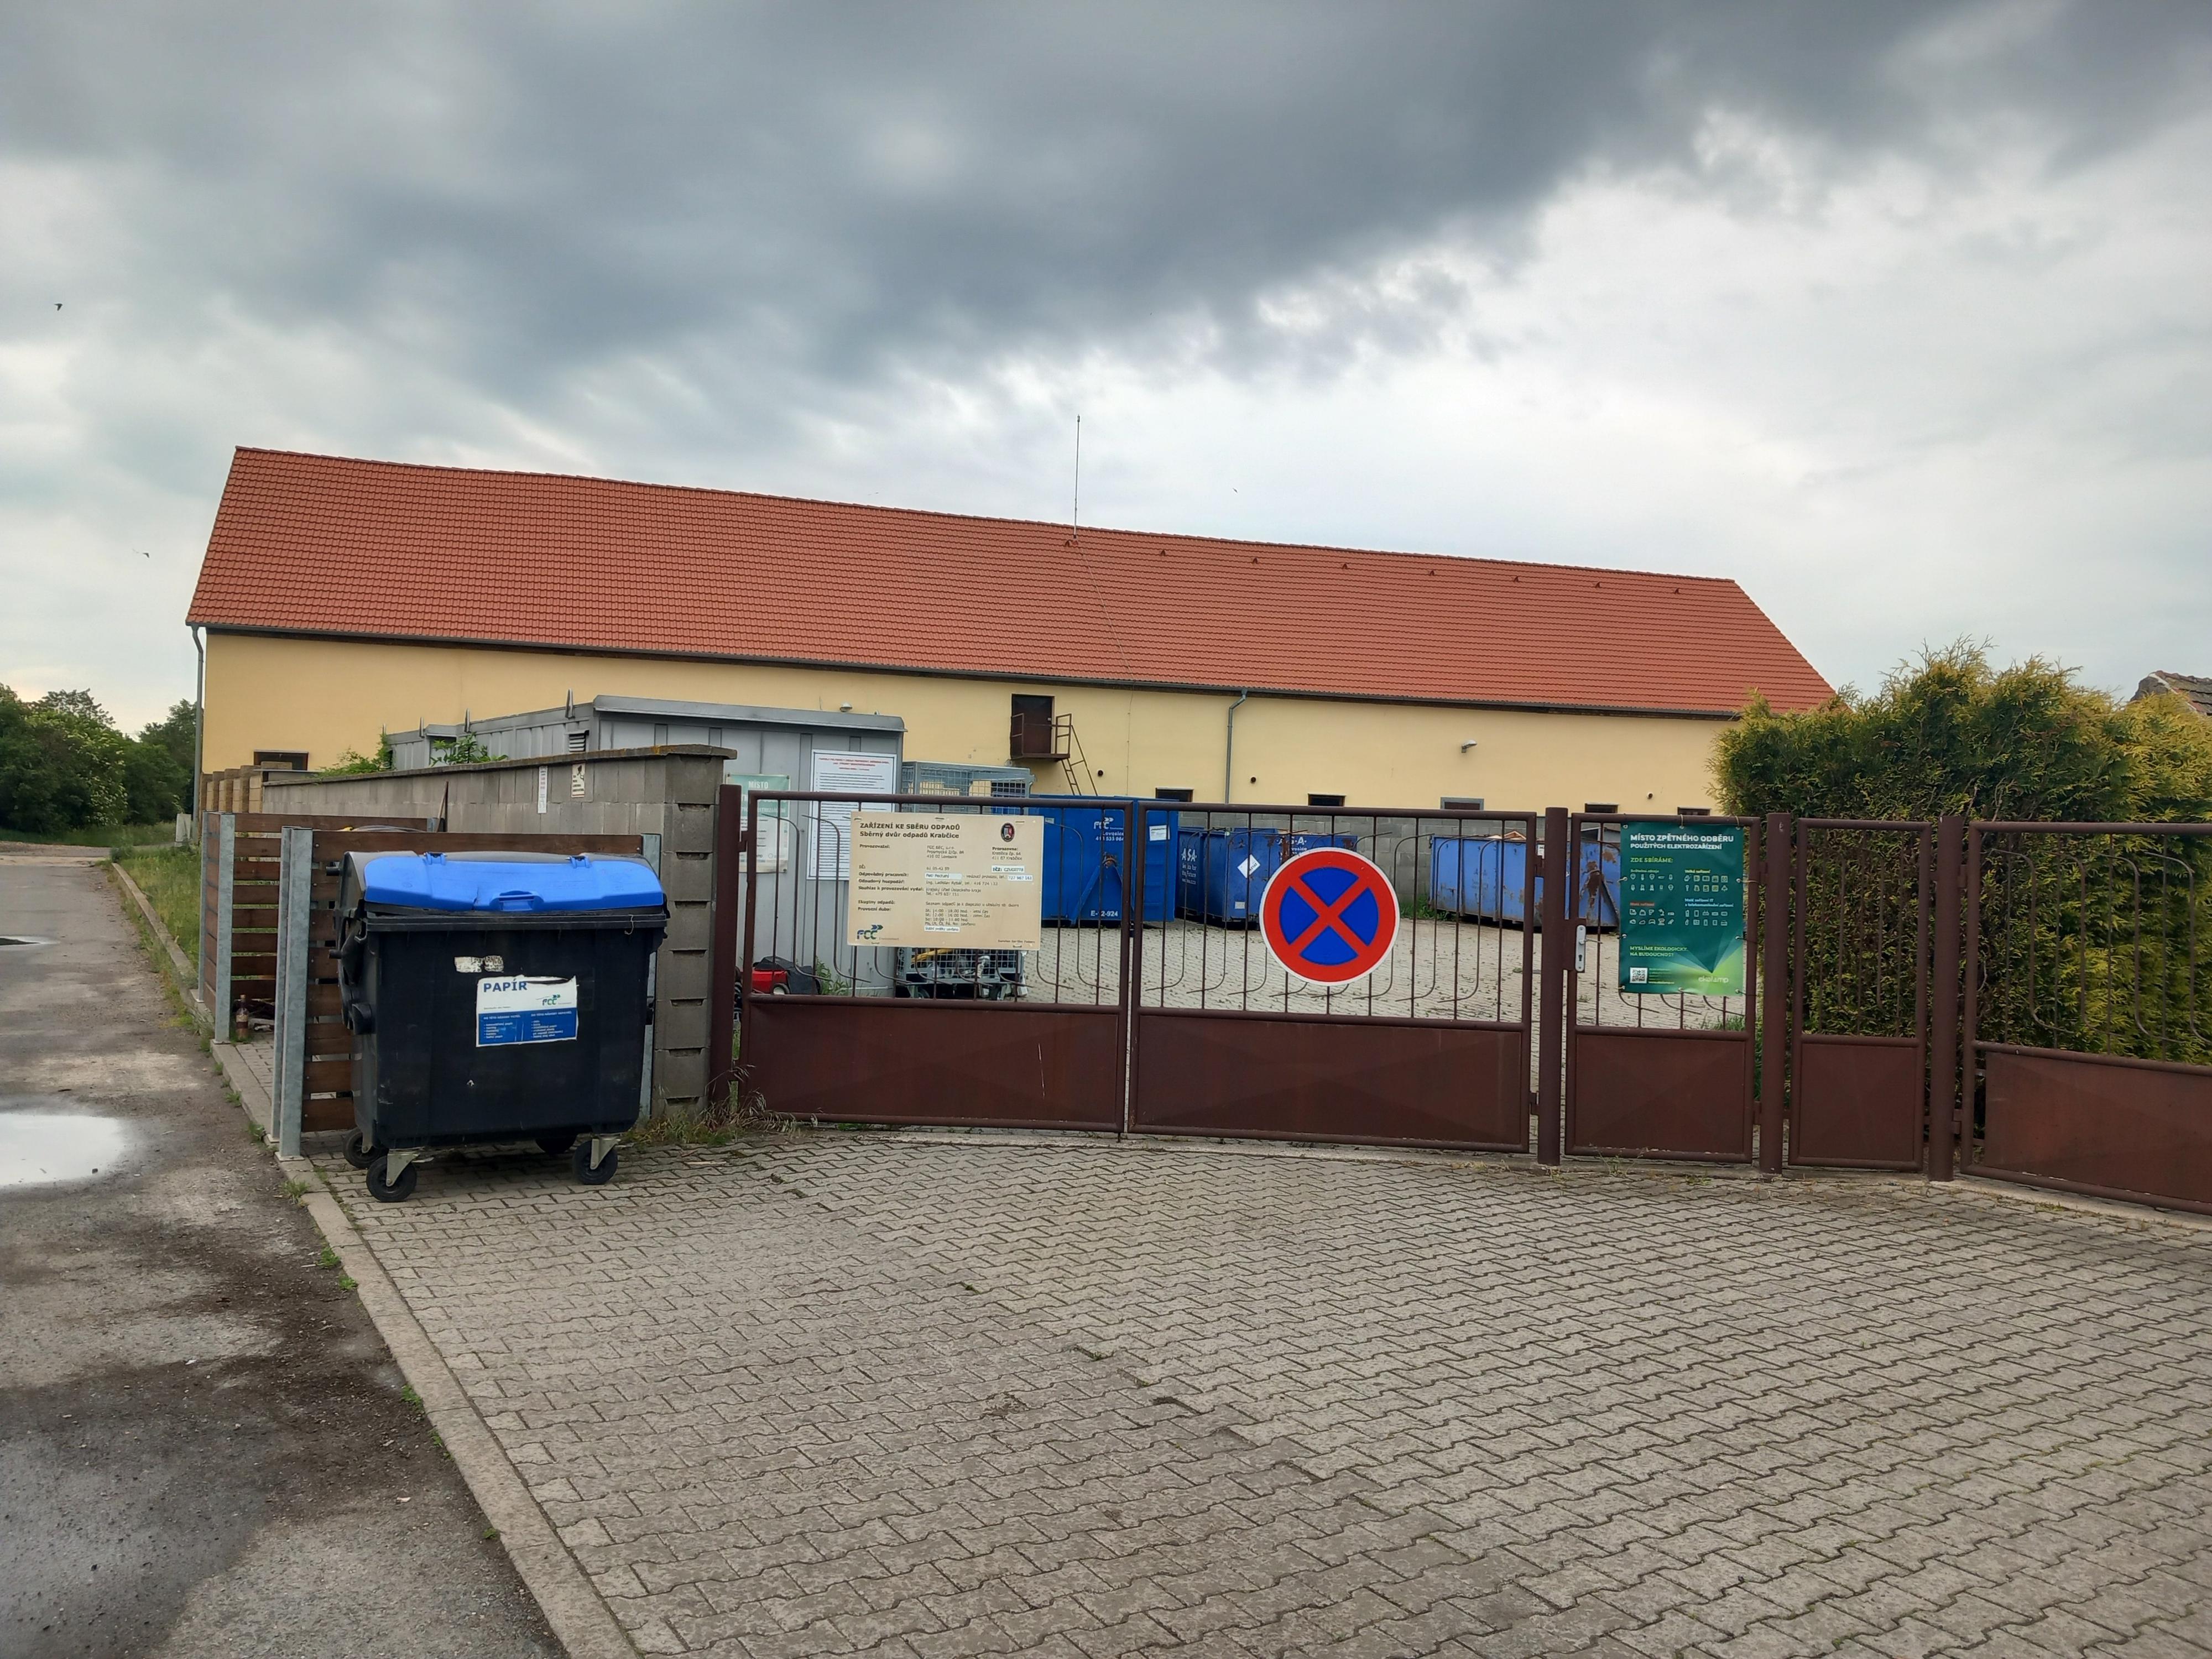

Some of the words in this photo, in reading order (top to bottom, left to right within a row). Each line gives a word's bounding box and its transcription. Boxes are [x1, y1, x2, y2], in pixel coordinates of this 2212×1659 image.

[748, 780, 769, 789] MÍSTO
[1630, 833, 1655, 841] MÍSTO
[1657, 833, 1699, 842] ZPĚTNÉHO
[1700, 834, 1734, 842] ODBĚRU
[857, 930, 878, 940] FCC
[483, 978, 528, 993] PAPÍR
